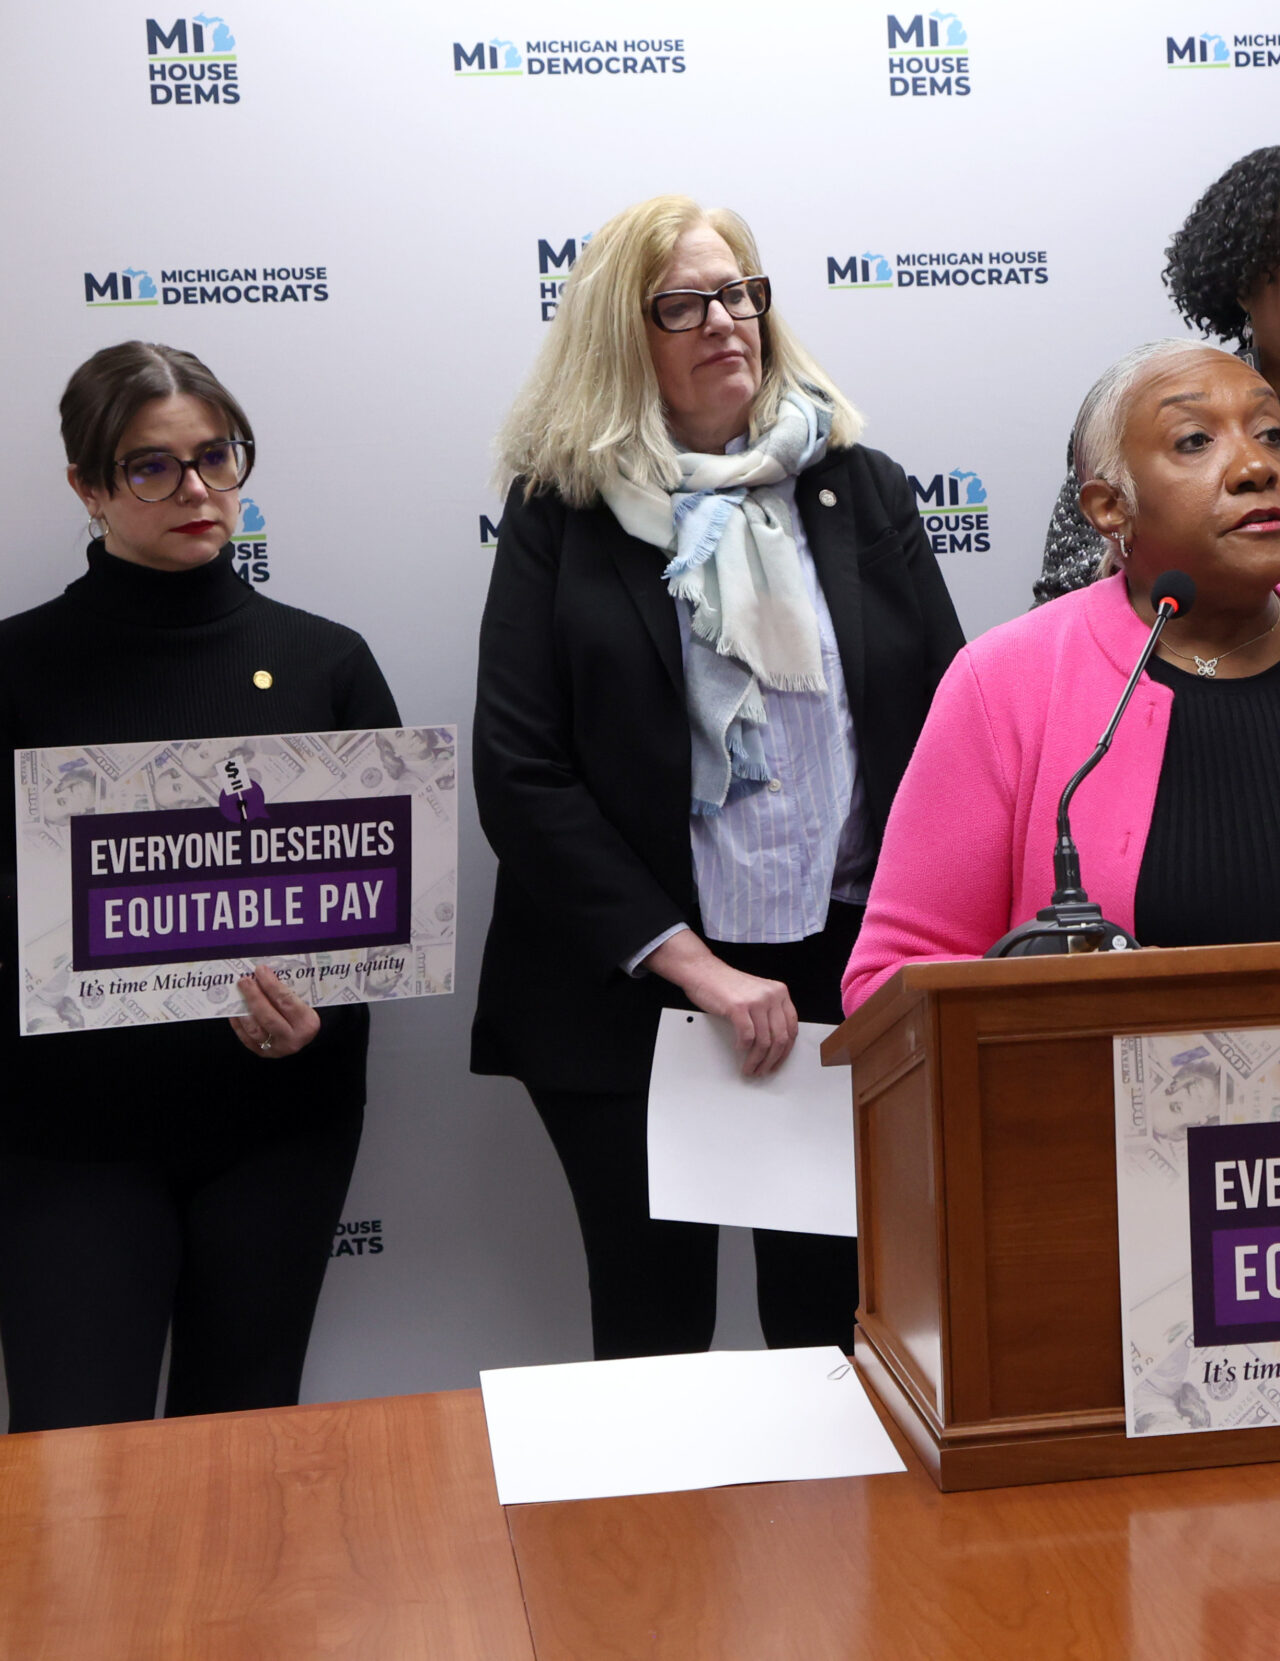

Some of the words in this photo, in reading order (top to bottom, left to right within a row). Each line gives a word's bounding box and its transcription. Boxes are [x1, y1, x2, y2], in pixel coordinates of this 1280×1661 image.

[146, 19, 204, 55] MI
[887, 16, 938, 49] MI
[454, 43, 497, 71] MI
[527, 41, 617, 53] MICHIGAN
[624, 40, 684, 52] HOUSE
[1167, 37, 1207, 63] MI
[149, 64, 237, 81] HOUSE
[528, 57, 685, 74] DEMOCRATS
[889, 58, 969, 73] HOUSE
[151, 84, 240, 104] DEMS
[890, 77, 970, 96] DEMS
[897, 253, 982, 266] MICHIGAN
[989, 252, 1047, 264] HOUSE
[162, 269, 256, 283] MICHIGAN
[263, 268, 326, 280] HOUSE
[827, 257, 869, 284] MI
[898, 268, 1048, 287] DEMOCRATS
[85, 273, 131, 302] MI
[163, 284, 328, 304] DEMOCRATS
[907, 474, 959, 507] MI
[920, 513, 989, 533] OUSE
[931, 532, 991, 554] EMS
[92, 831, 241, 875] EVERYONE
[251, 821, 394, 863] DESERVES
[105, 887, 303, 938] EQUITABLE
[320, 881, 383, 922] PAY
[78, 978, 104, 998] It's
[109, 978, 148, 995] time
[152, 970, 235, 994] Michigan
[296, 965, 316, 979] on
[319, 961, 352, 983] pay
[354, 956, 406, 977] equity
[334, 1220, 382, 1236] OUSE
[1202, 1358, 1237, 1385] It's
